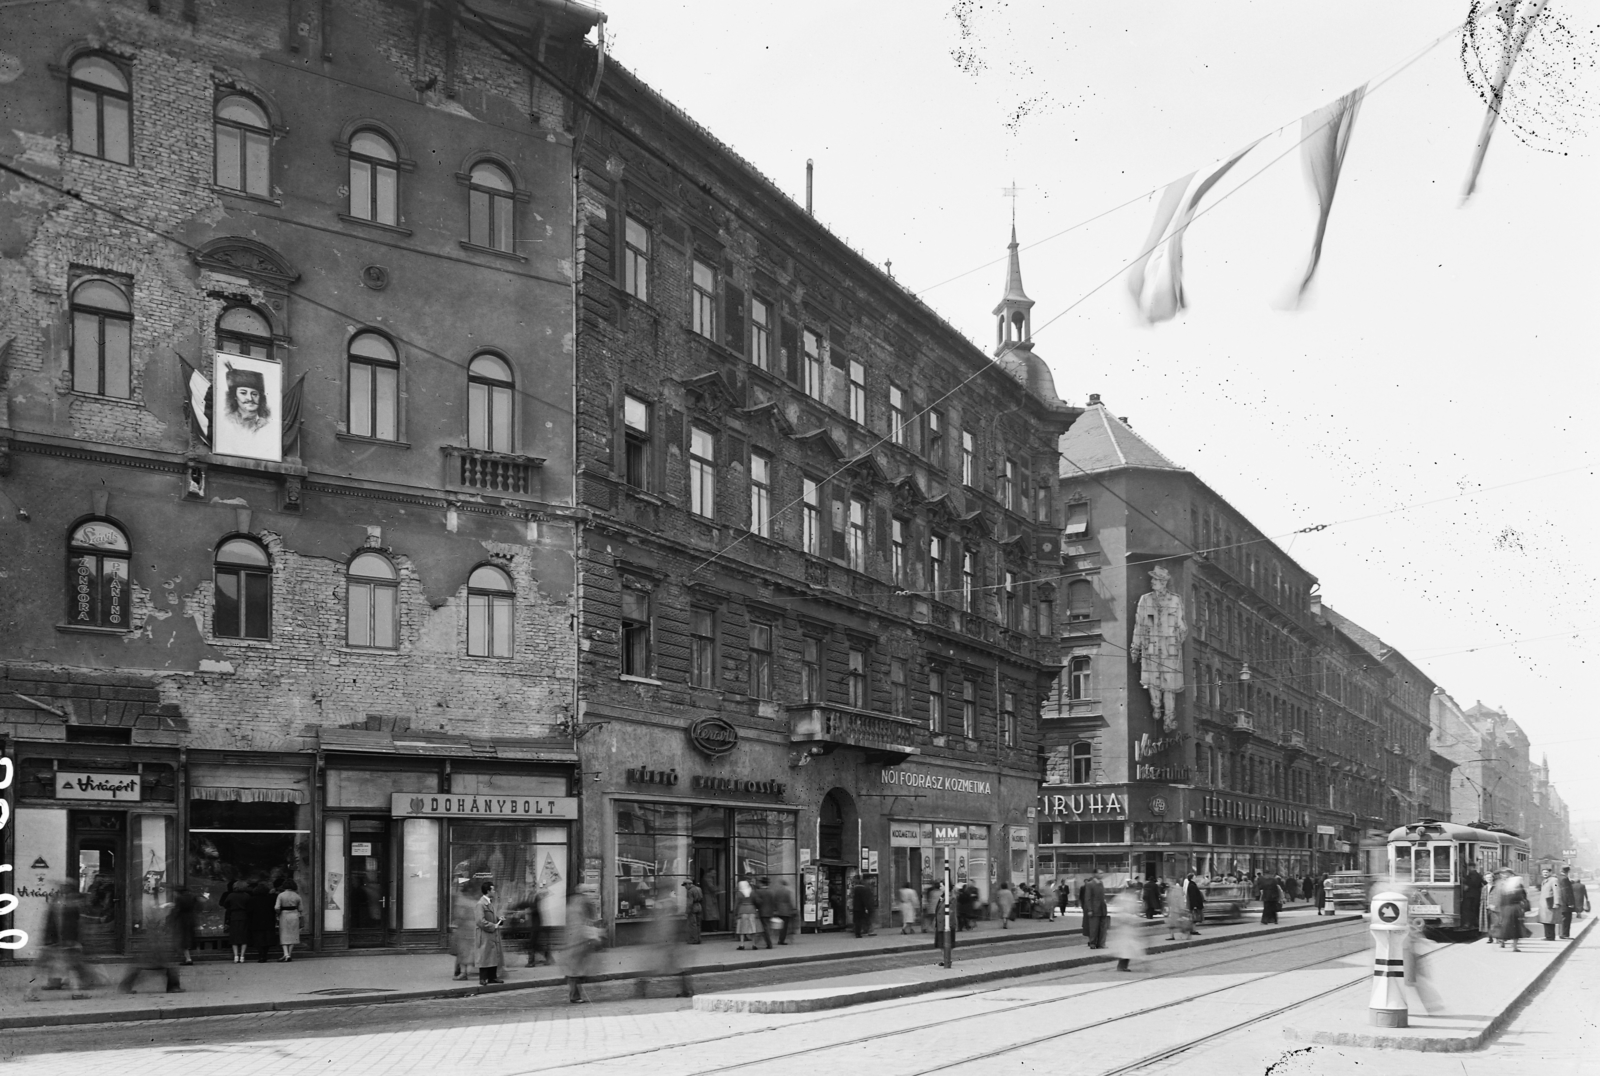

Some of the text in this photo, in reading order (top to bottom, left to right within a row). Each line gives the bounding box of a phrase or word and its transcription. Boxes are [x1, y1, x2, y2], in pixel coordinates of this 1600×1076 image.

[77, 557, 90, 621] ZONGORA
[110, 562, 121, 624] PIANINO
[77, 775, 138, 798] Virágért
[900, 771, 943, 790] FODRÁSZ
[944, 777, 991, 795] KOZMETIKA
[431, 795, 556, 815] DOHÁNYBOLT
